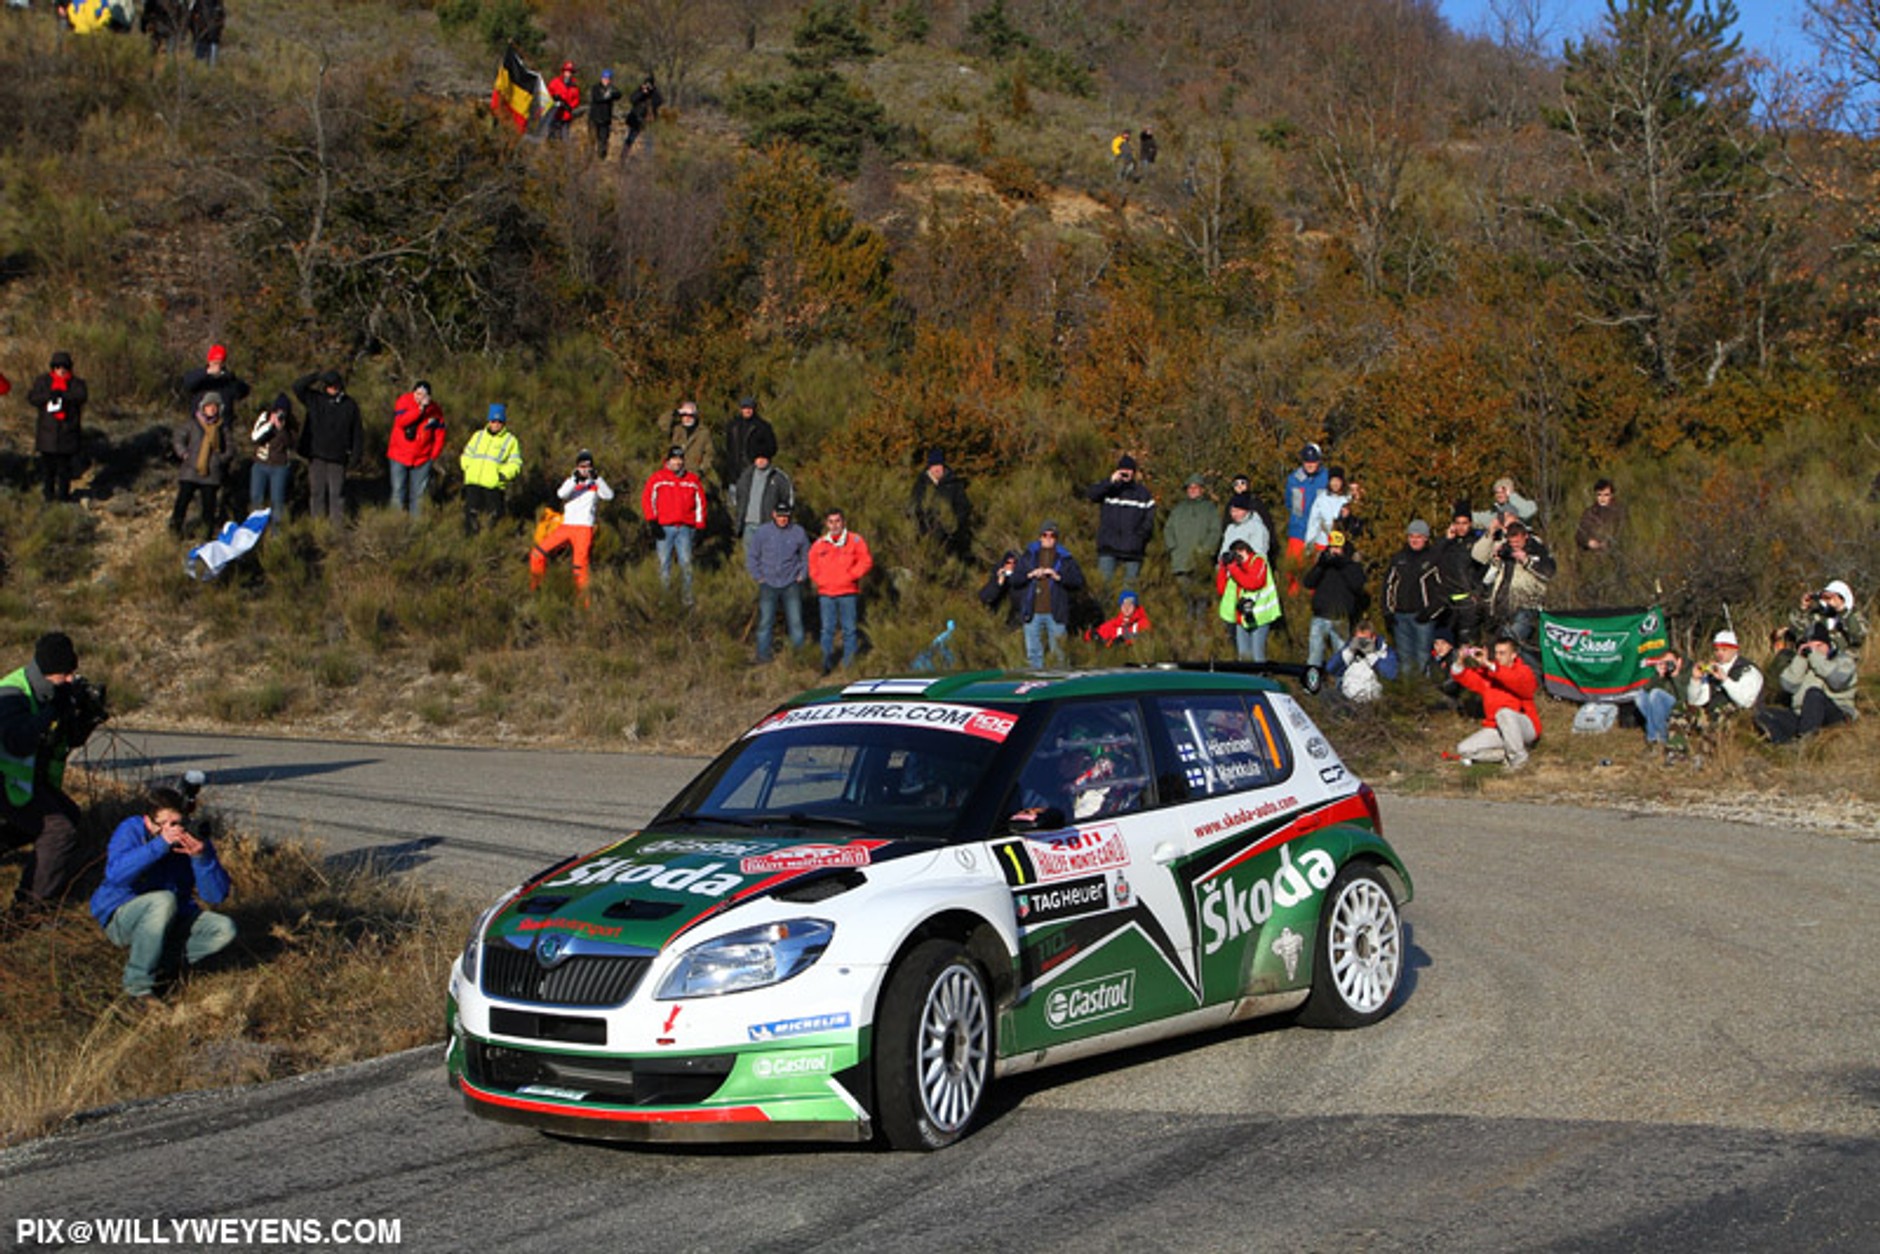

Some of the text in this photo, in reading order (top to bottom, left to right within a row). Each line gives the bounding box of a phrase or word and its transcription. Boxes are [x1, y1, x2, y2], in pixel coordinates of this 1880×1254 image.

[779, 705, 972, 727] RALLY-IRC.COM
[1252, 704, 1282, 769] 1
[1194, 795, 1299, 839] www.skoda-auto.com
[1049, 832, 1102, 851] 2011
[1003, 844, 1025, 885] 1
[1202, 843, 1336, 955] Škoda
[1068, 977, 1128, 1018] Castrol
[774, 1013, 848, 1033] MICHELIN
[772, 1055, 827, 1075] Castrol
